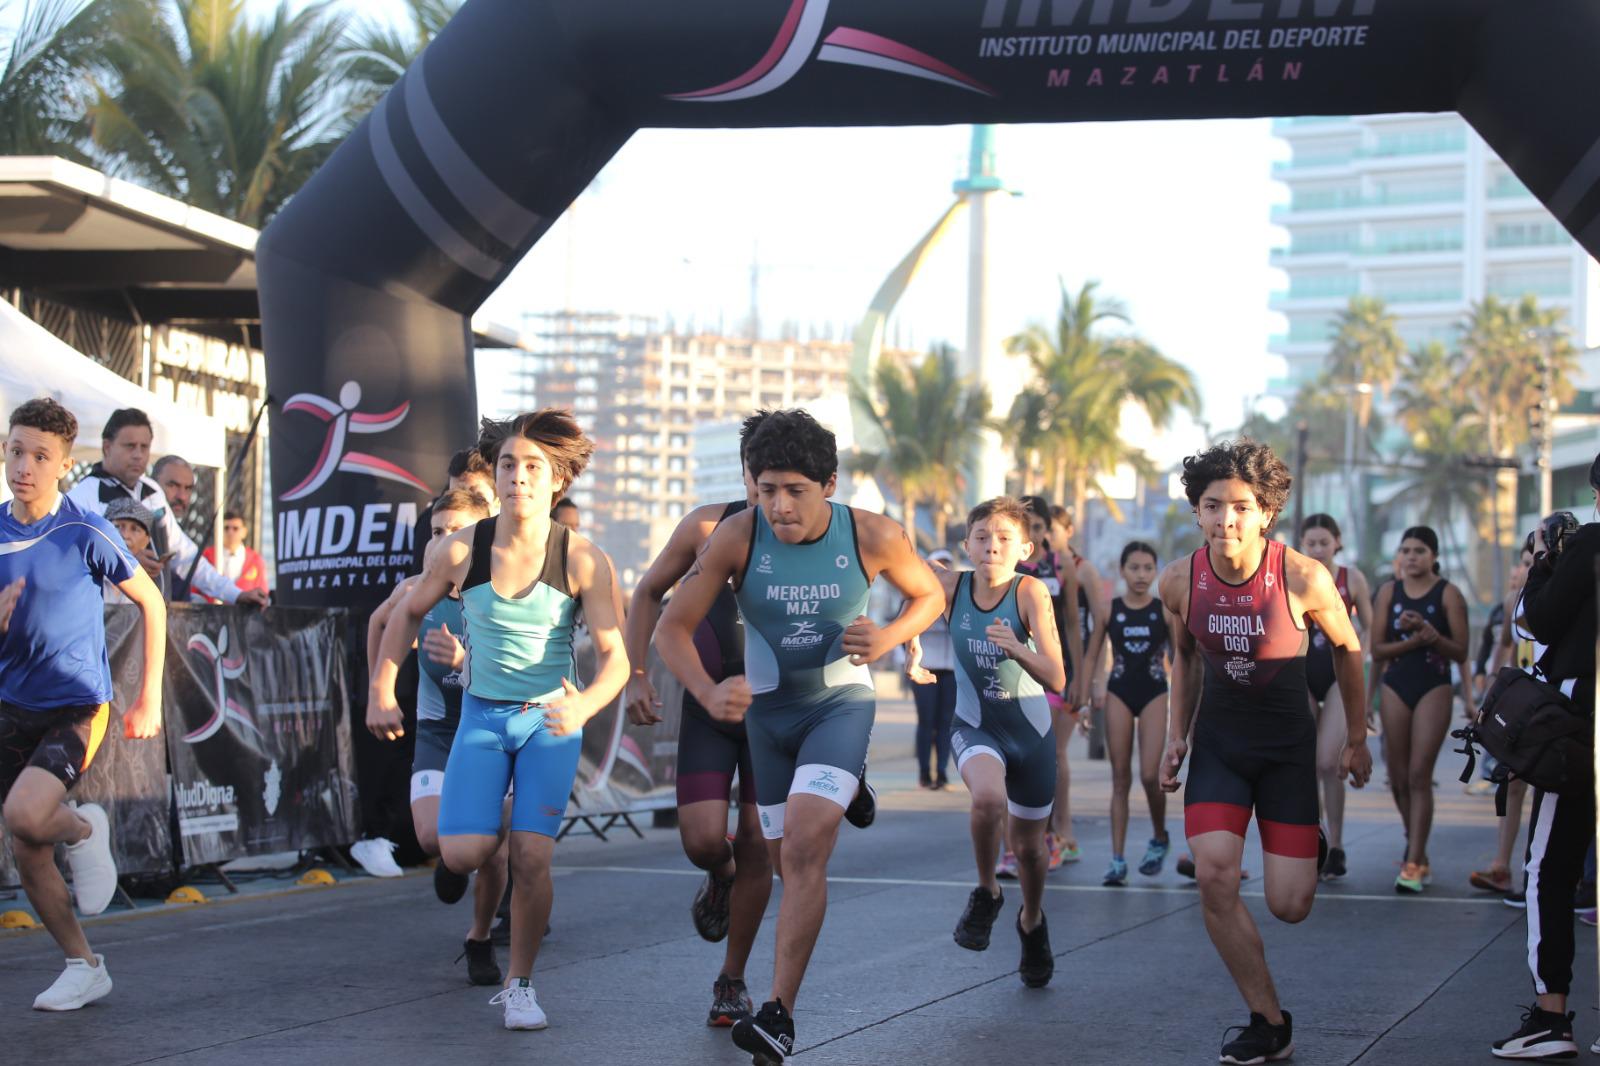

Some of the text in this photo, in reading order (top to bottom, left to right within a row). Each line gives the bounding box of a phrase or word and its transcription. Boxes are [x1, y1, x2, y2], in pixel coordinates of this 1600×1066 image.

[979, 25, 1369, 57] INSTITUTO MUNICIPAL DEL DEPORTE
[1046, 58, 1303, 88] MAZATLÁN
[310, 557, 364, 571] MUNICIPAL
[366, 556, 387, 567] DEL
[766, 583, 841, 601] MERCADO
[786, 600, 820, 616] MAZ
[1208, 614, 1266, 636] GURROLA
[780, 634, 824, 645] IMDEM
[1223, 635, 1250, 653] DGO
[975, 655, 1000, 670] MAZ
[983, 689, 1011, 700] IMDEM
